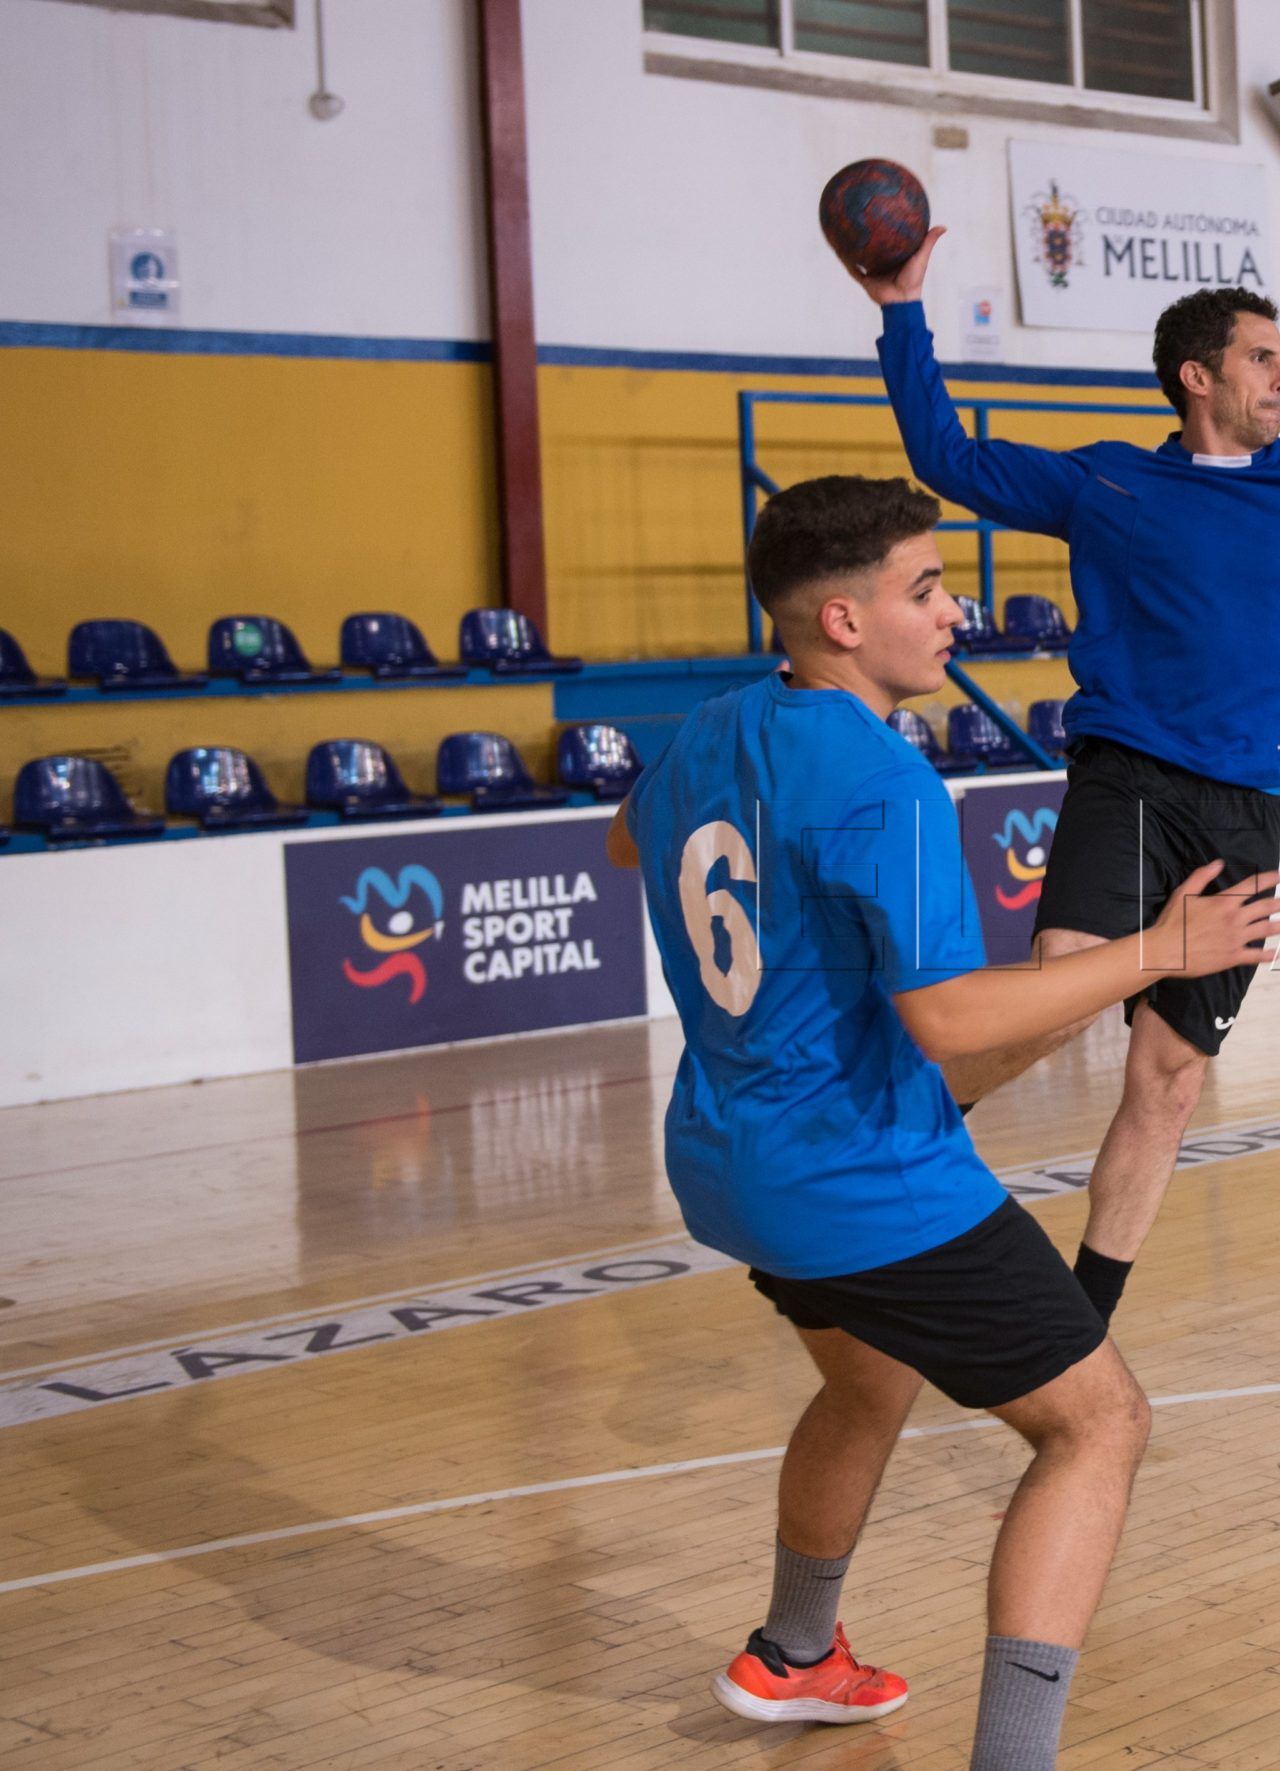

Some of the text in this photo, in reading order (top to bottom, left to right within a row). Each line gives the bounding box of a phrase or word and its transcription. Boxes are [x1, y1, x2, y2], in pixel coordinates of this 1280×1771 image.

[1096, 206, 1157, 229] CIUDAD
[1102, 234, 1263, 286] MELILLA
[461, 872, 597, 915] MELILLA
[463, 908, 573, 949] SPORT
[678, 820, 763, 1018] 6
[464, 940, 601, 984] CAPITAL
[37, 1259, 692, 1403] LÁZARO
